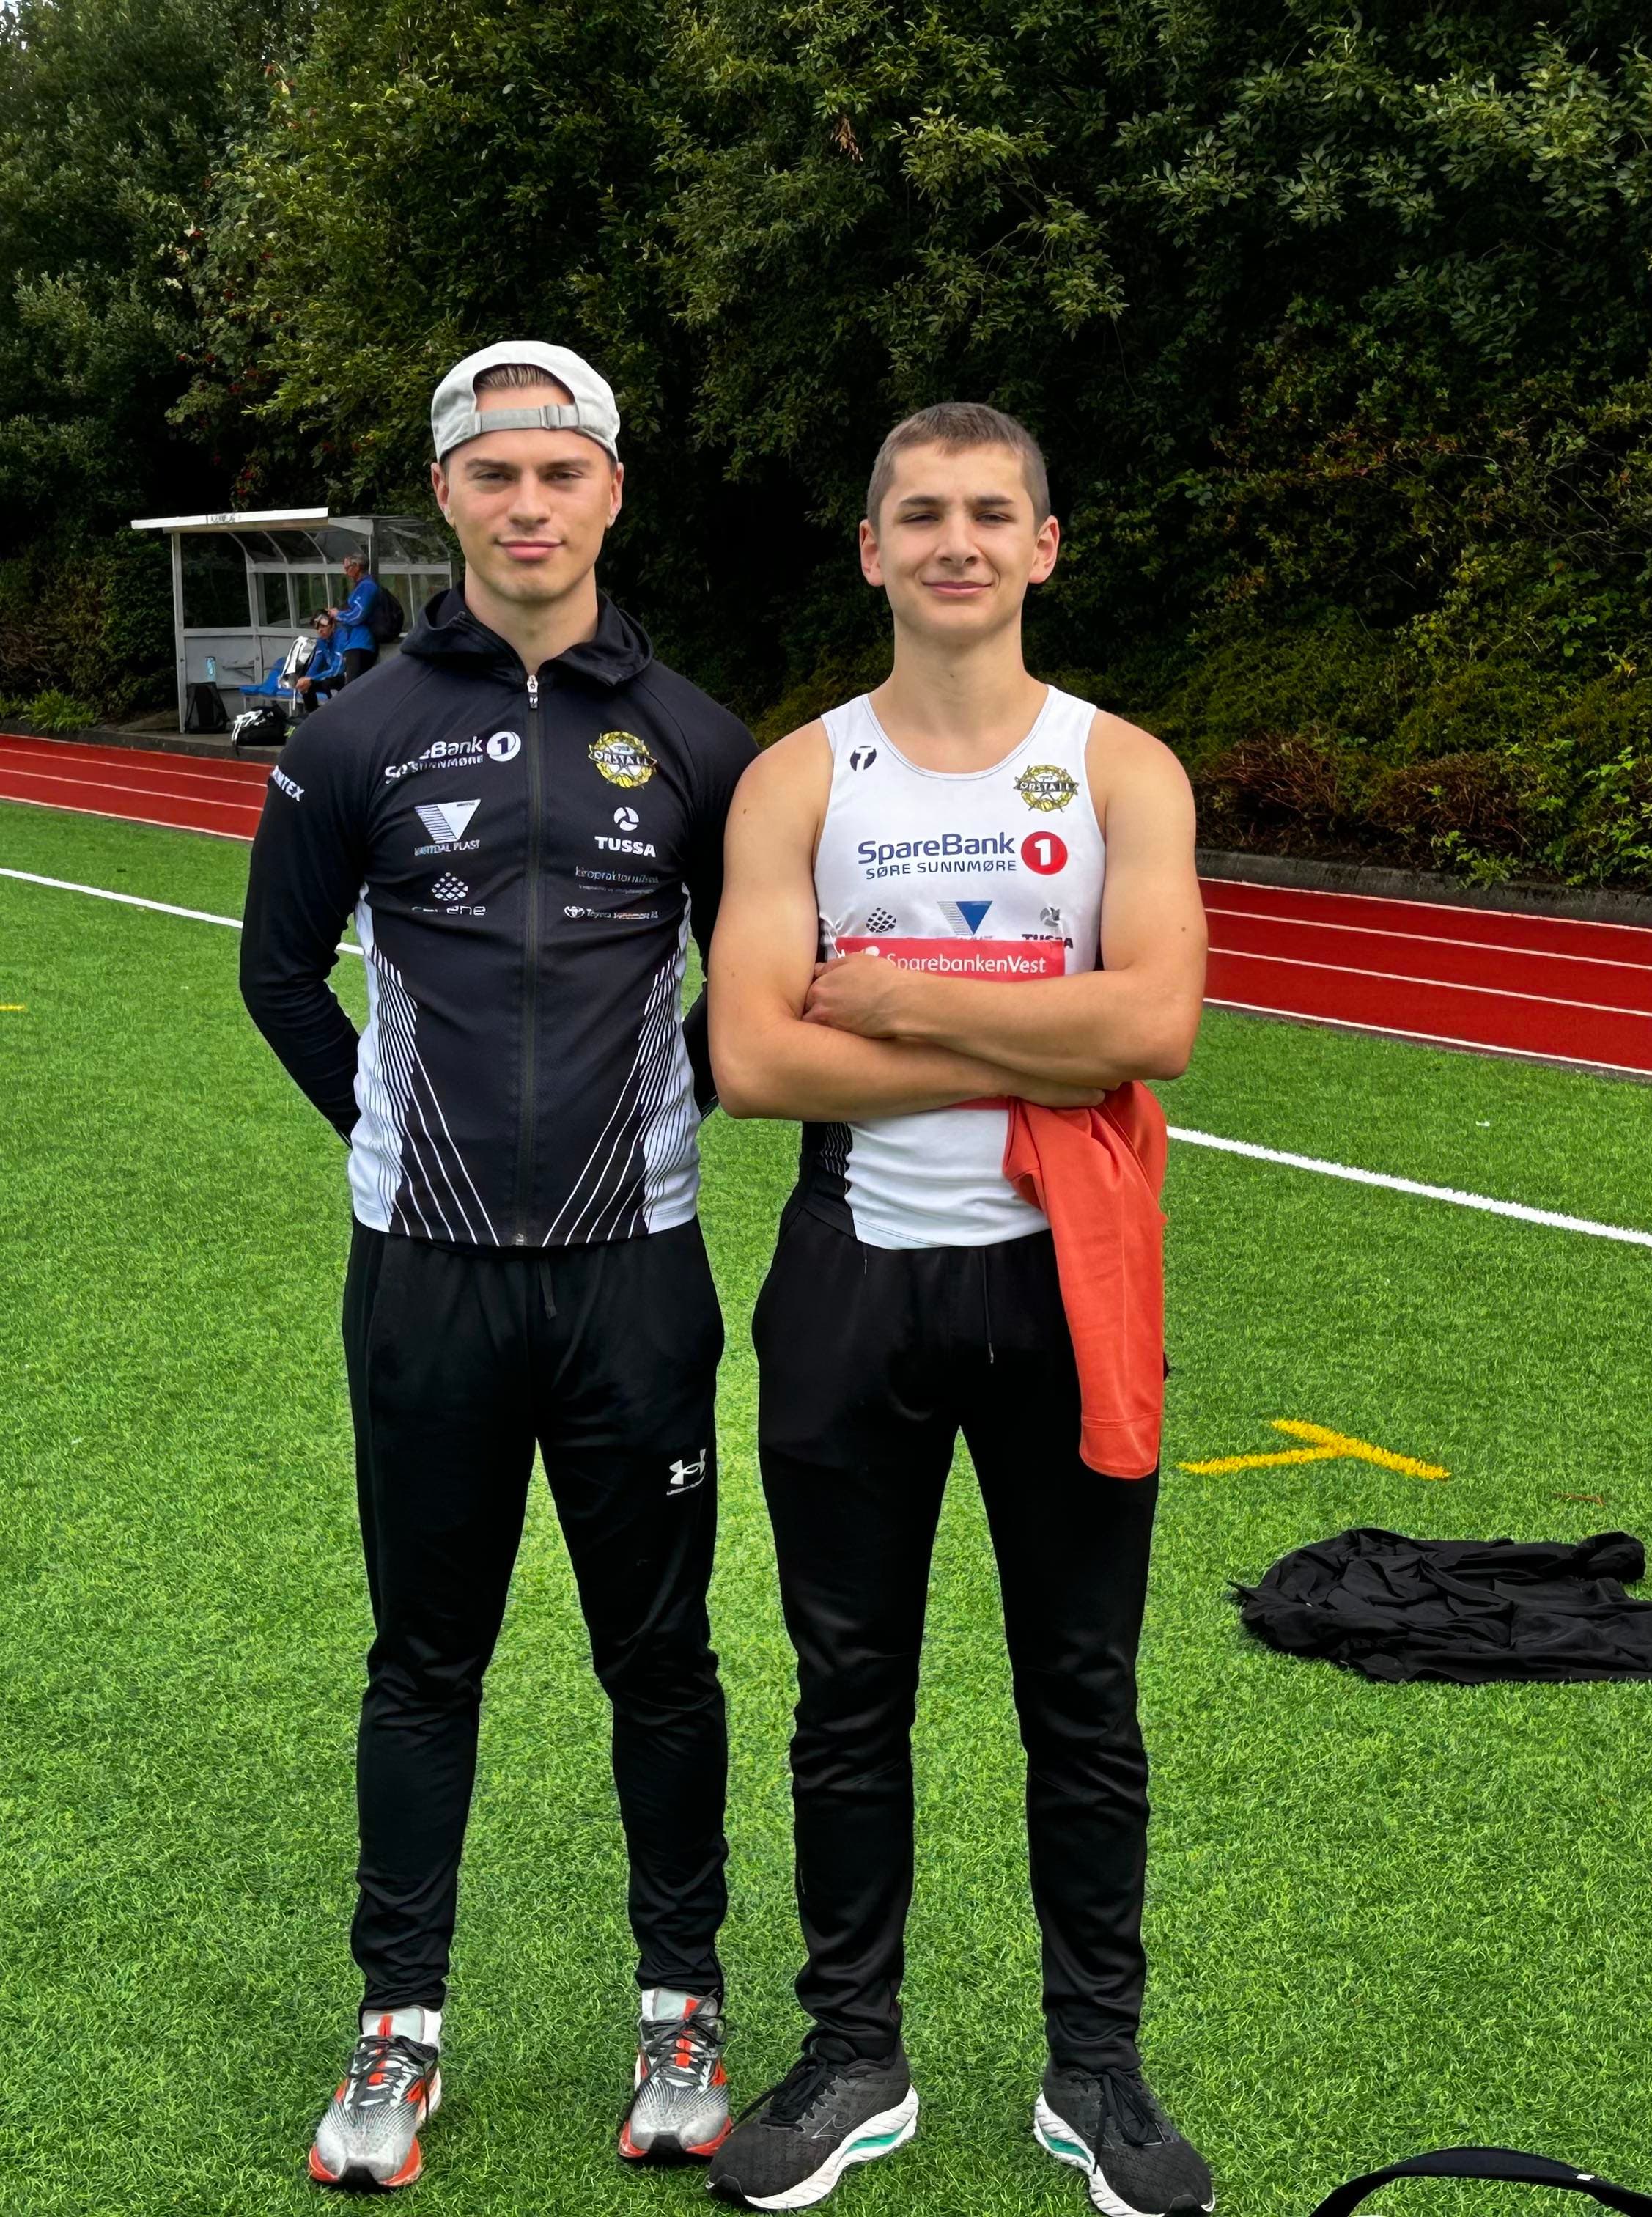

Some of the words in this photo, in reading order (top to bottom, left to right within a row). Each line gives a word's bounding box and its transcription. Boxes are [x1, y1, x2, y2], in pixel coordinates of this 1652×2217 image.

[453, 839, 481, 852] PLAST
[594, 836, 657, 858] TUSSA
[858, 831, 1016, 865] SpareBank
[866, 863, 912, 880] SØRE
[916, 859, 1017, 874] SUNNMØRE
